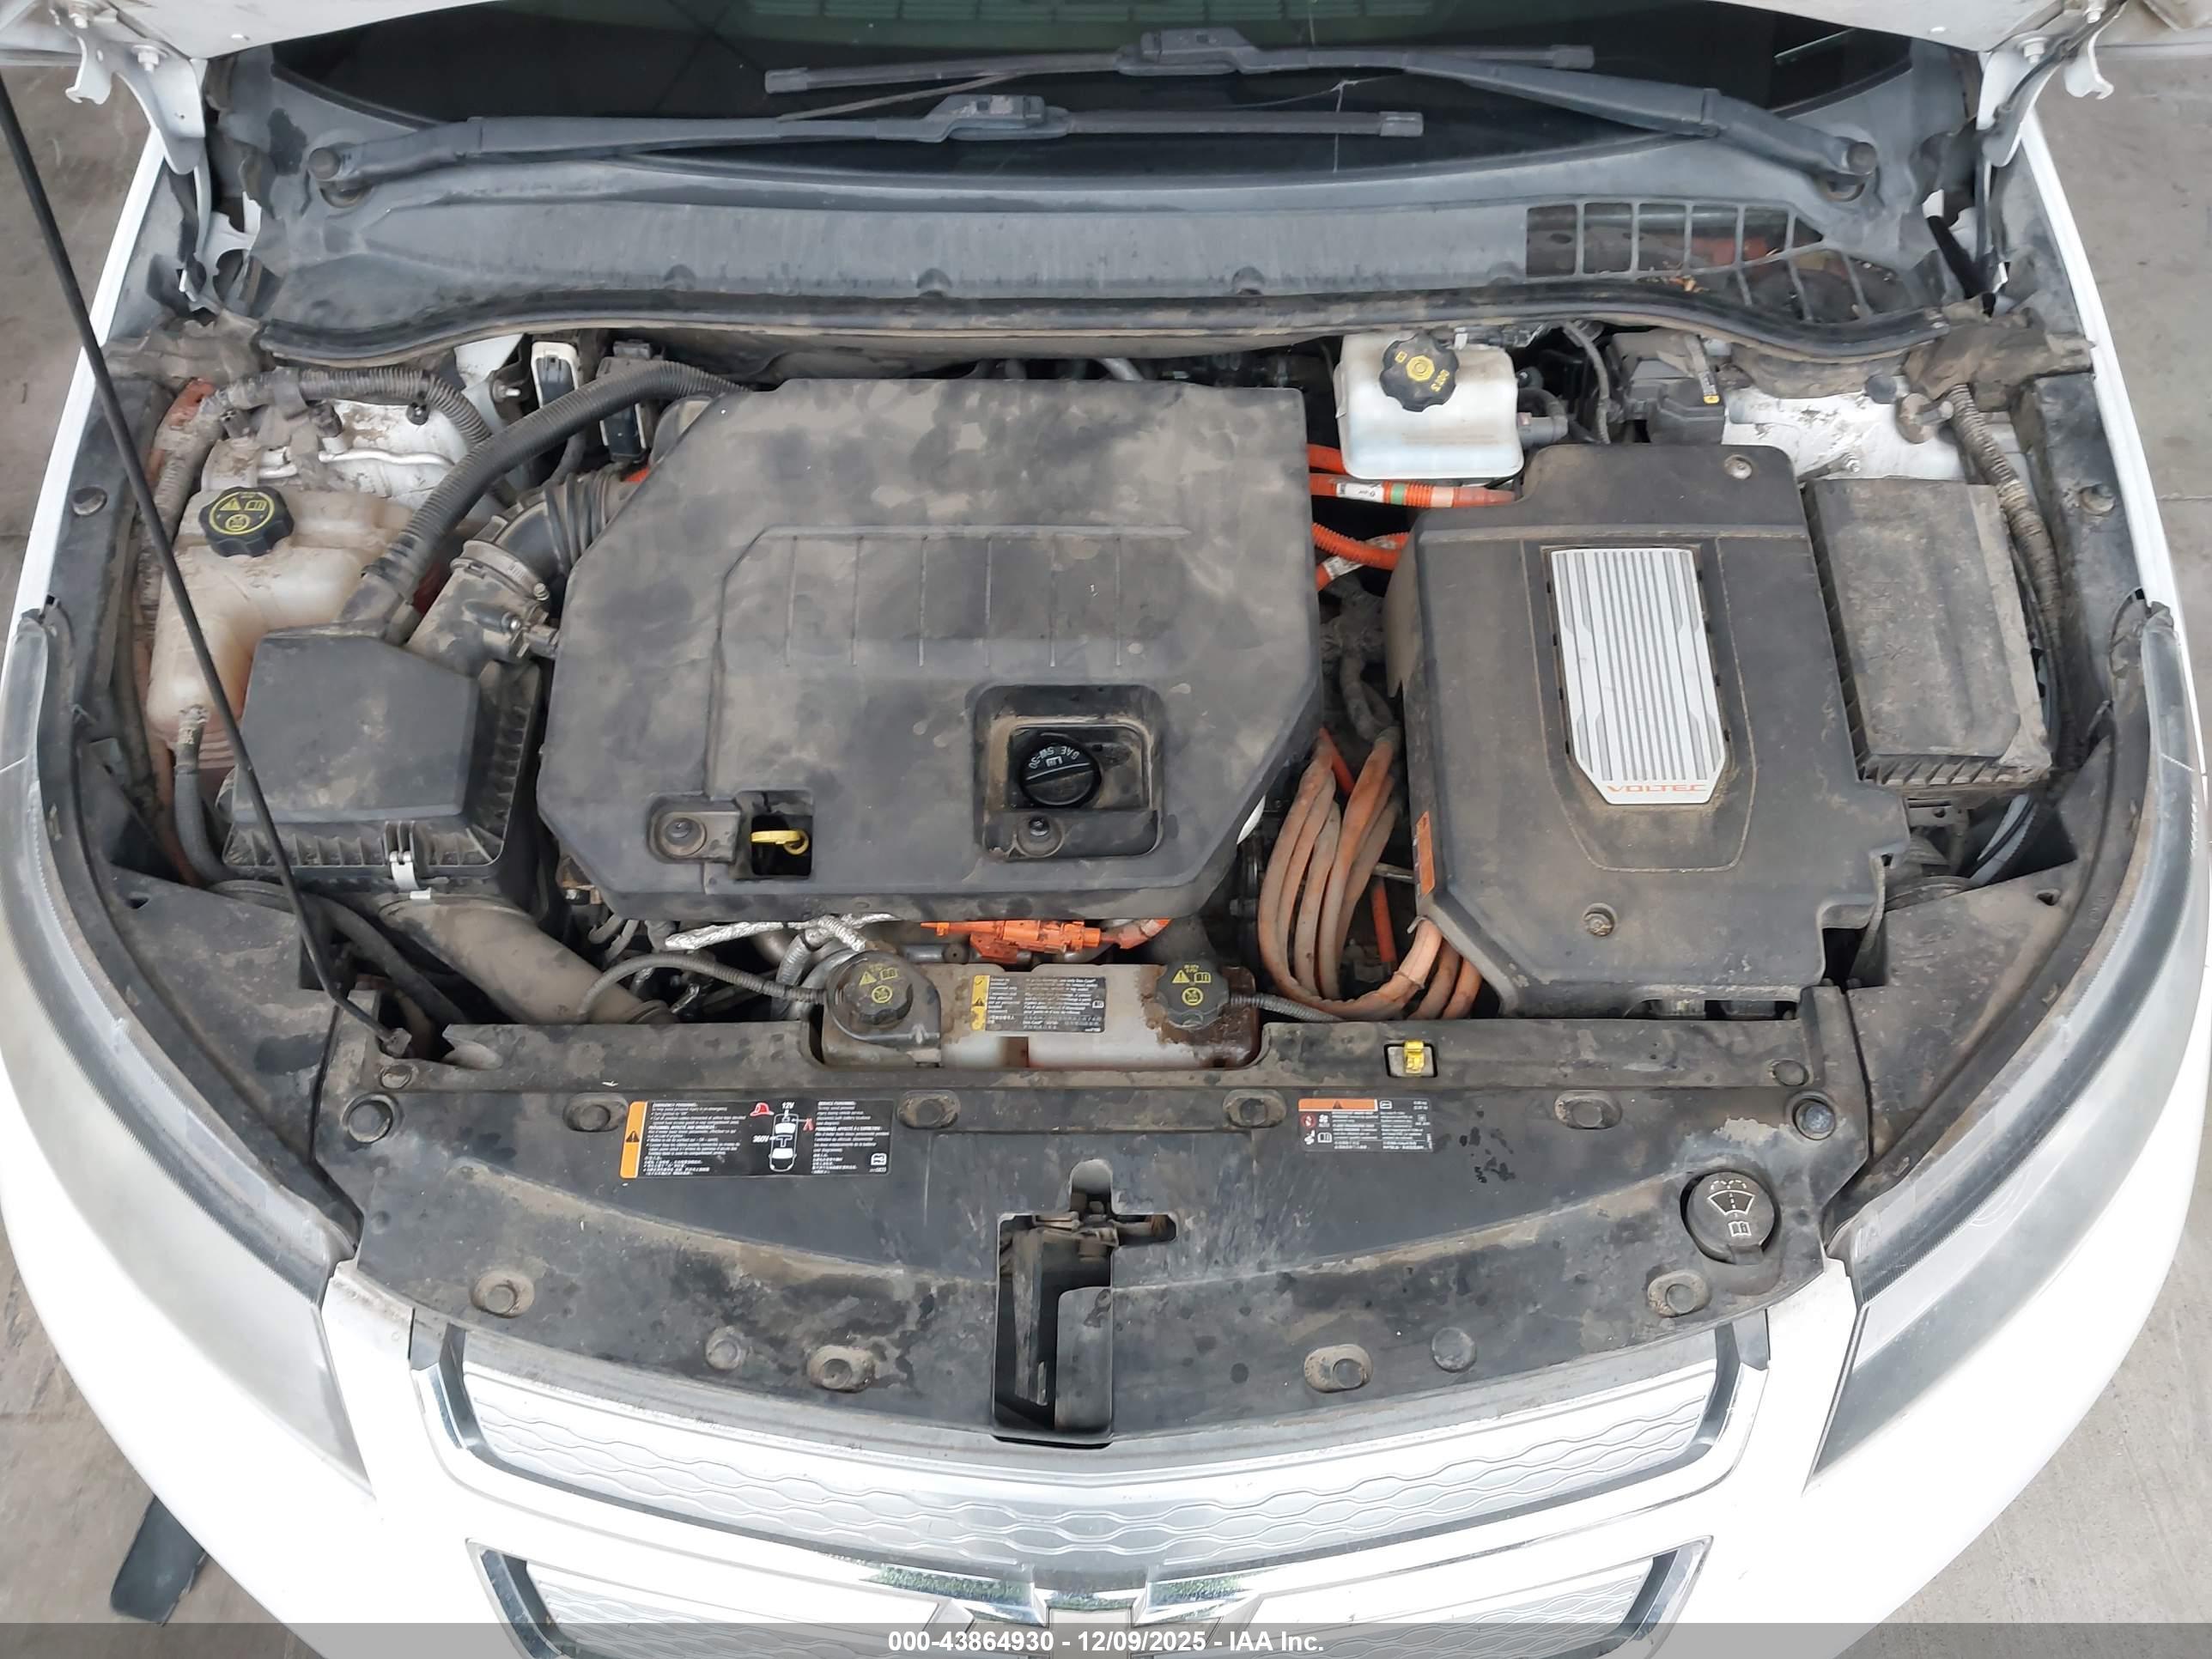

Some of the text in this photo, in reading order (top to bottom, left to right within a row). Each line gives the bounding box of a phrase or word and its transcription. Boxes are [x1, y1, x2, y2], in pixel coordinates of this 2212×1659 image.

[1060, 745, 1080, 760] SAE
[1607, 783, 1707, 793] VOLTEC
[752, 1134, 769, 1143] 360V
